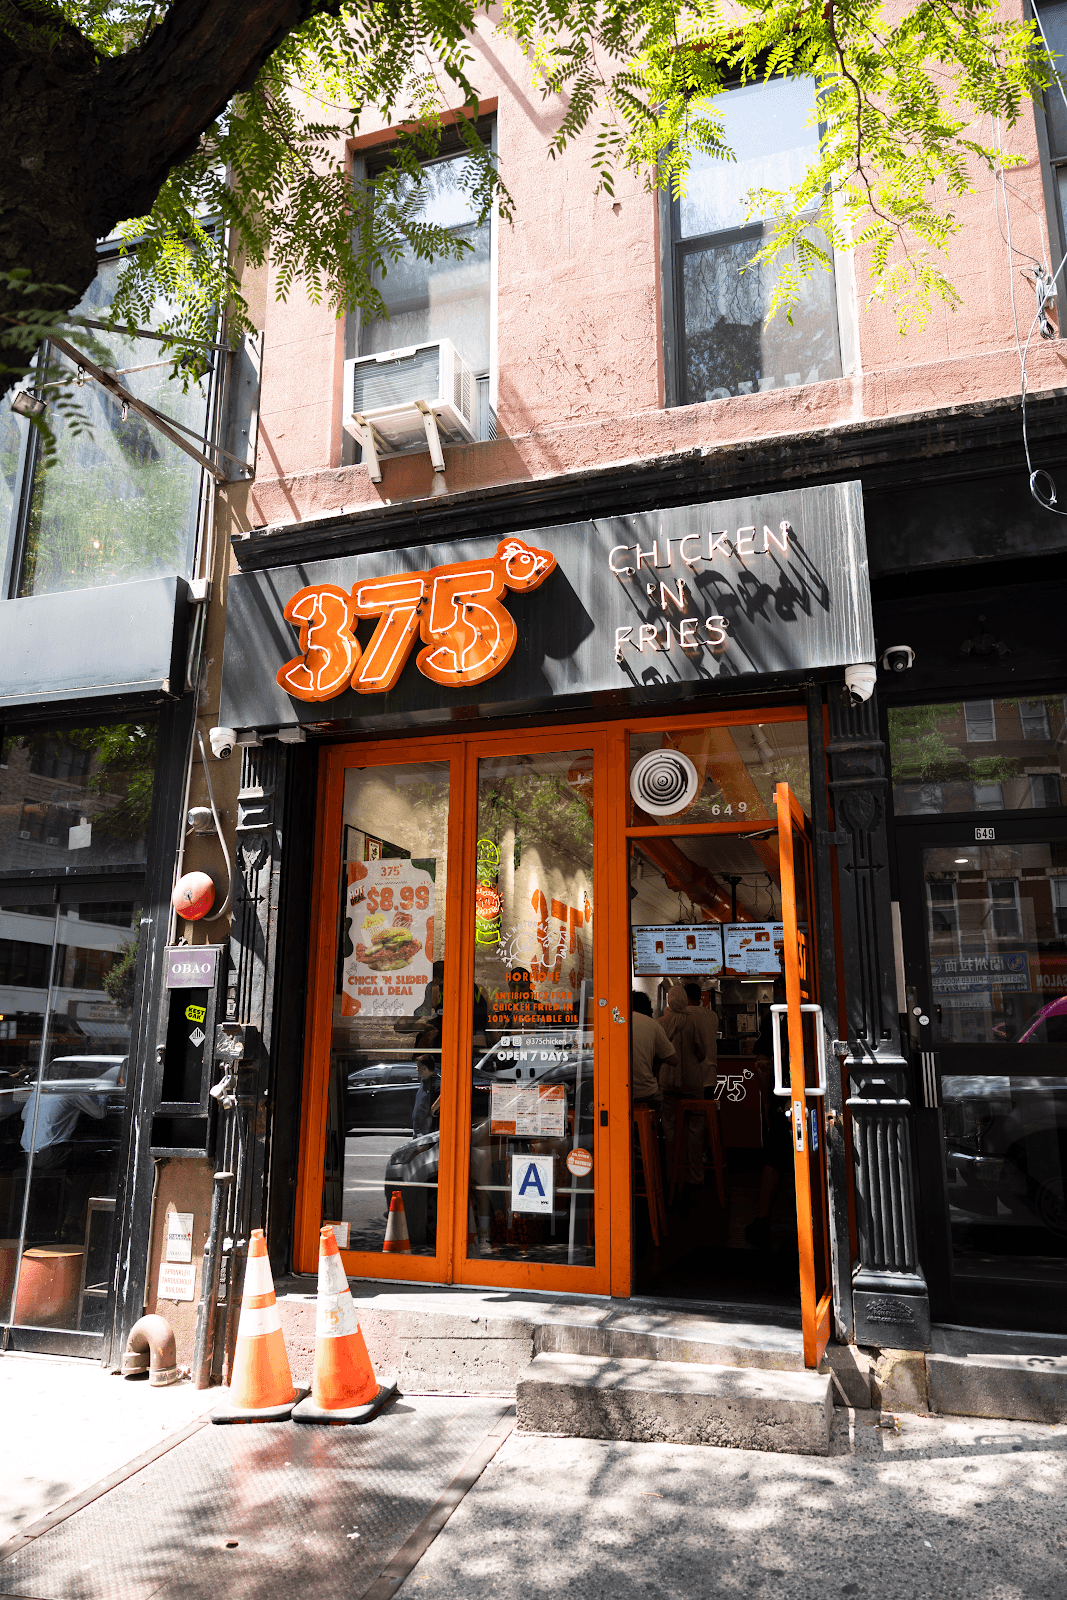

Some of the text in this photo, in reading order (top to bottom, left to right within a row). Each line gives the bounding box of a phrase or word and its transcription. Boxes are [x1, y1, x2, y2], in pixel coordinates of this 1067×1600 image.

[608, 522, 790, 574] CHICKEN
[614, 615, 729, 658] FRIES
[711, 802, 747, 815] 649
[975, 828, 994, 839] 649
[380, 866, 400, 877] 375
[349, 885, 365, 899] HOT
[350, 894, 366, 906] DEAL
[366, 886, 430, 914] $8.99
[500, 920, 548, 947] ALL NATURAL
[171, 962, 211, 974] OBAO
[347, 975, 428, 985] CHICK 'N SLIDER
[506, 972, 561, 982] HORMONE
[357, 986, 413, 996] MEAL DEAL
[494, 992, 572, 1000] ANTIBIOTICS FREE
[492, 1003, 573, 1011] CHICKEN FRIED IN
[487, 1014, 579, 1023] 100% VEGETABLE OIL
[525, 1037, 567, 1046] @375chicken
[497, 1050, 569, 1062] OPEN 7 DAYS
[714, 1075, 747, 1101] 75
[518, 1163, 546, 1197] A
[164, 1268, 191, 1277] SPRINKLER
[161, 1277, 192, 1286] THROUGHOUT
[165, 1286, 187, 1294] BUILDING
